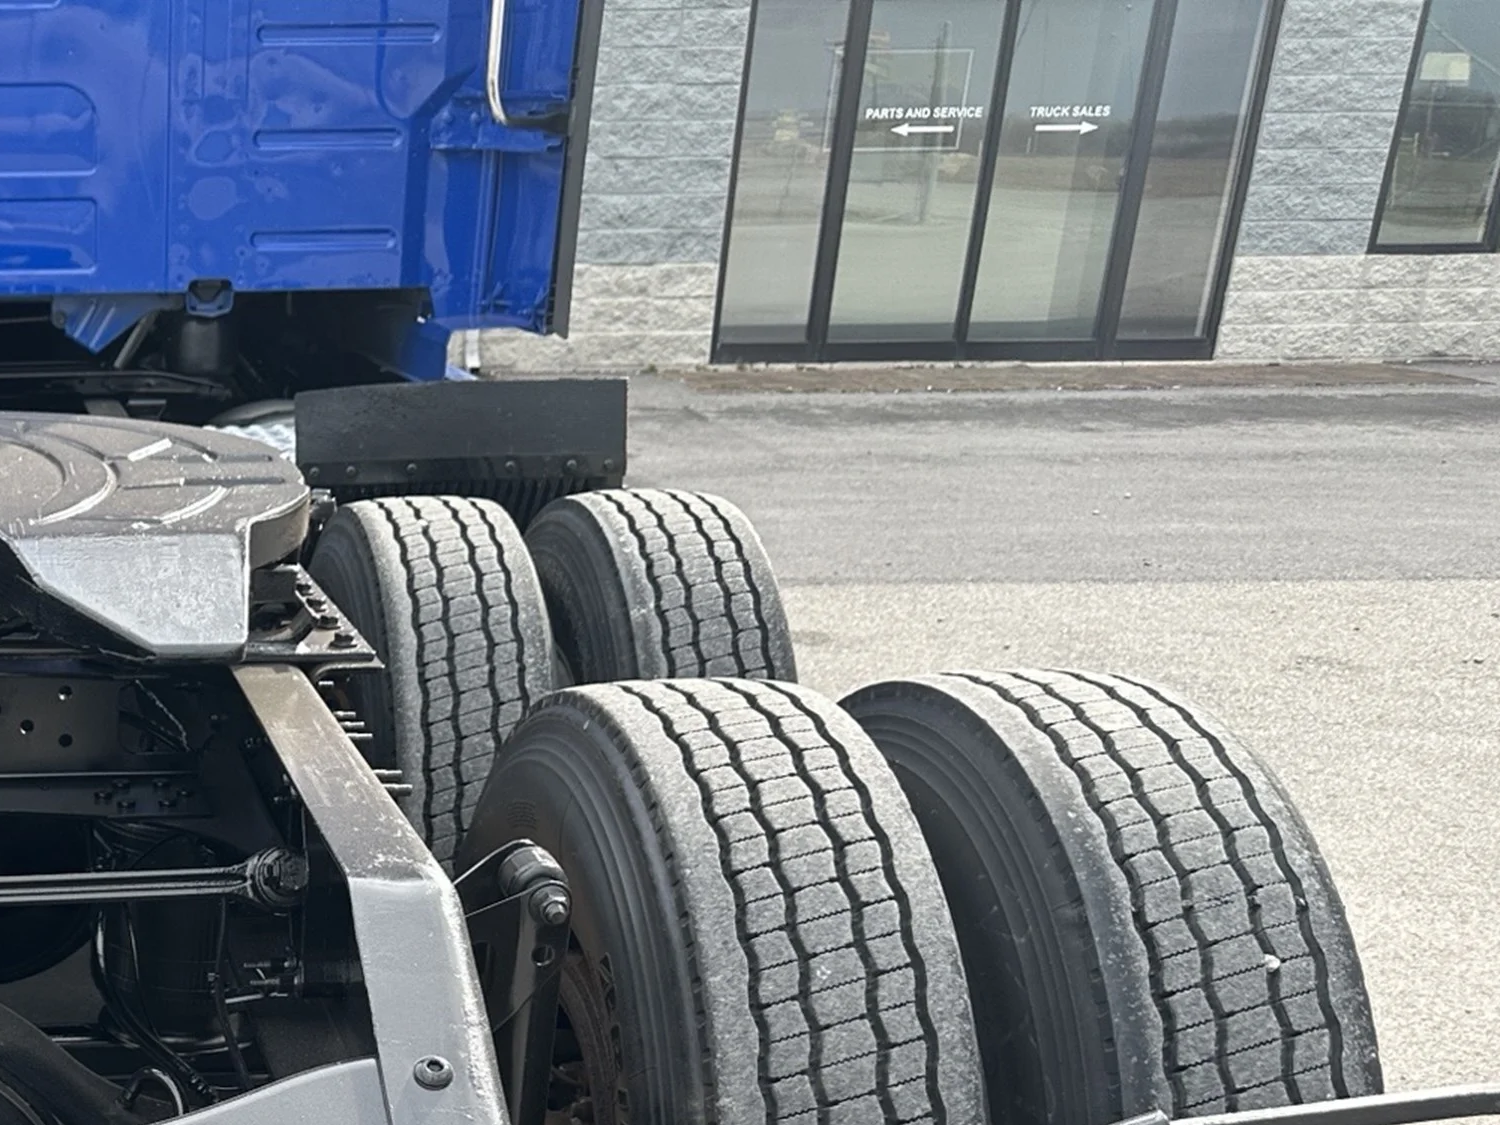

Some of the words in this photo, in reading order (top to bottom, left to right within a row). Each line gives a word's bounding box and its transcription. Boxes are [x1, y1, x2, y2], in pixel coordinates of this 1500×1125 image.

[865, 107, 904, 119] PARTS
[904, 107, 931, 119] AND
[932, 106, 984, 118] SERVICE
[1030, 105, 1070, 118] TRUCK
[1071, 105, 1111, 118] SALES
